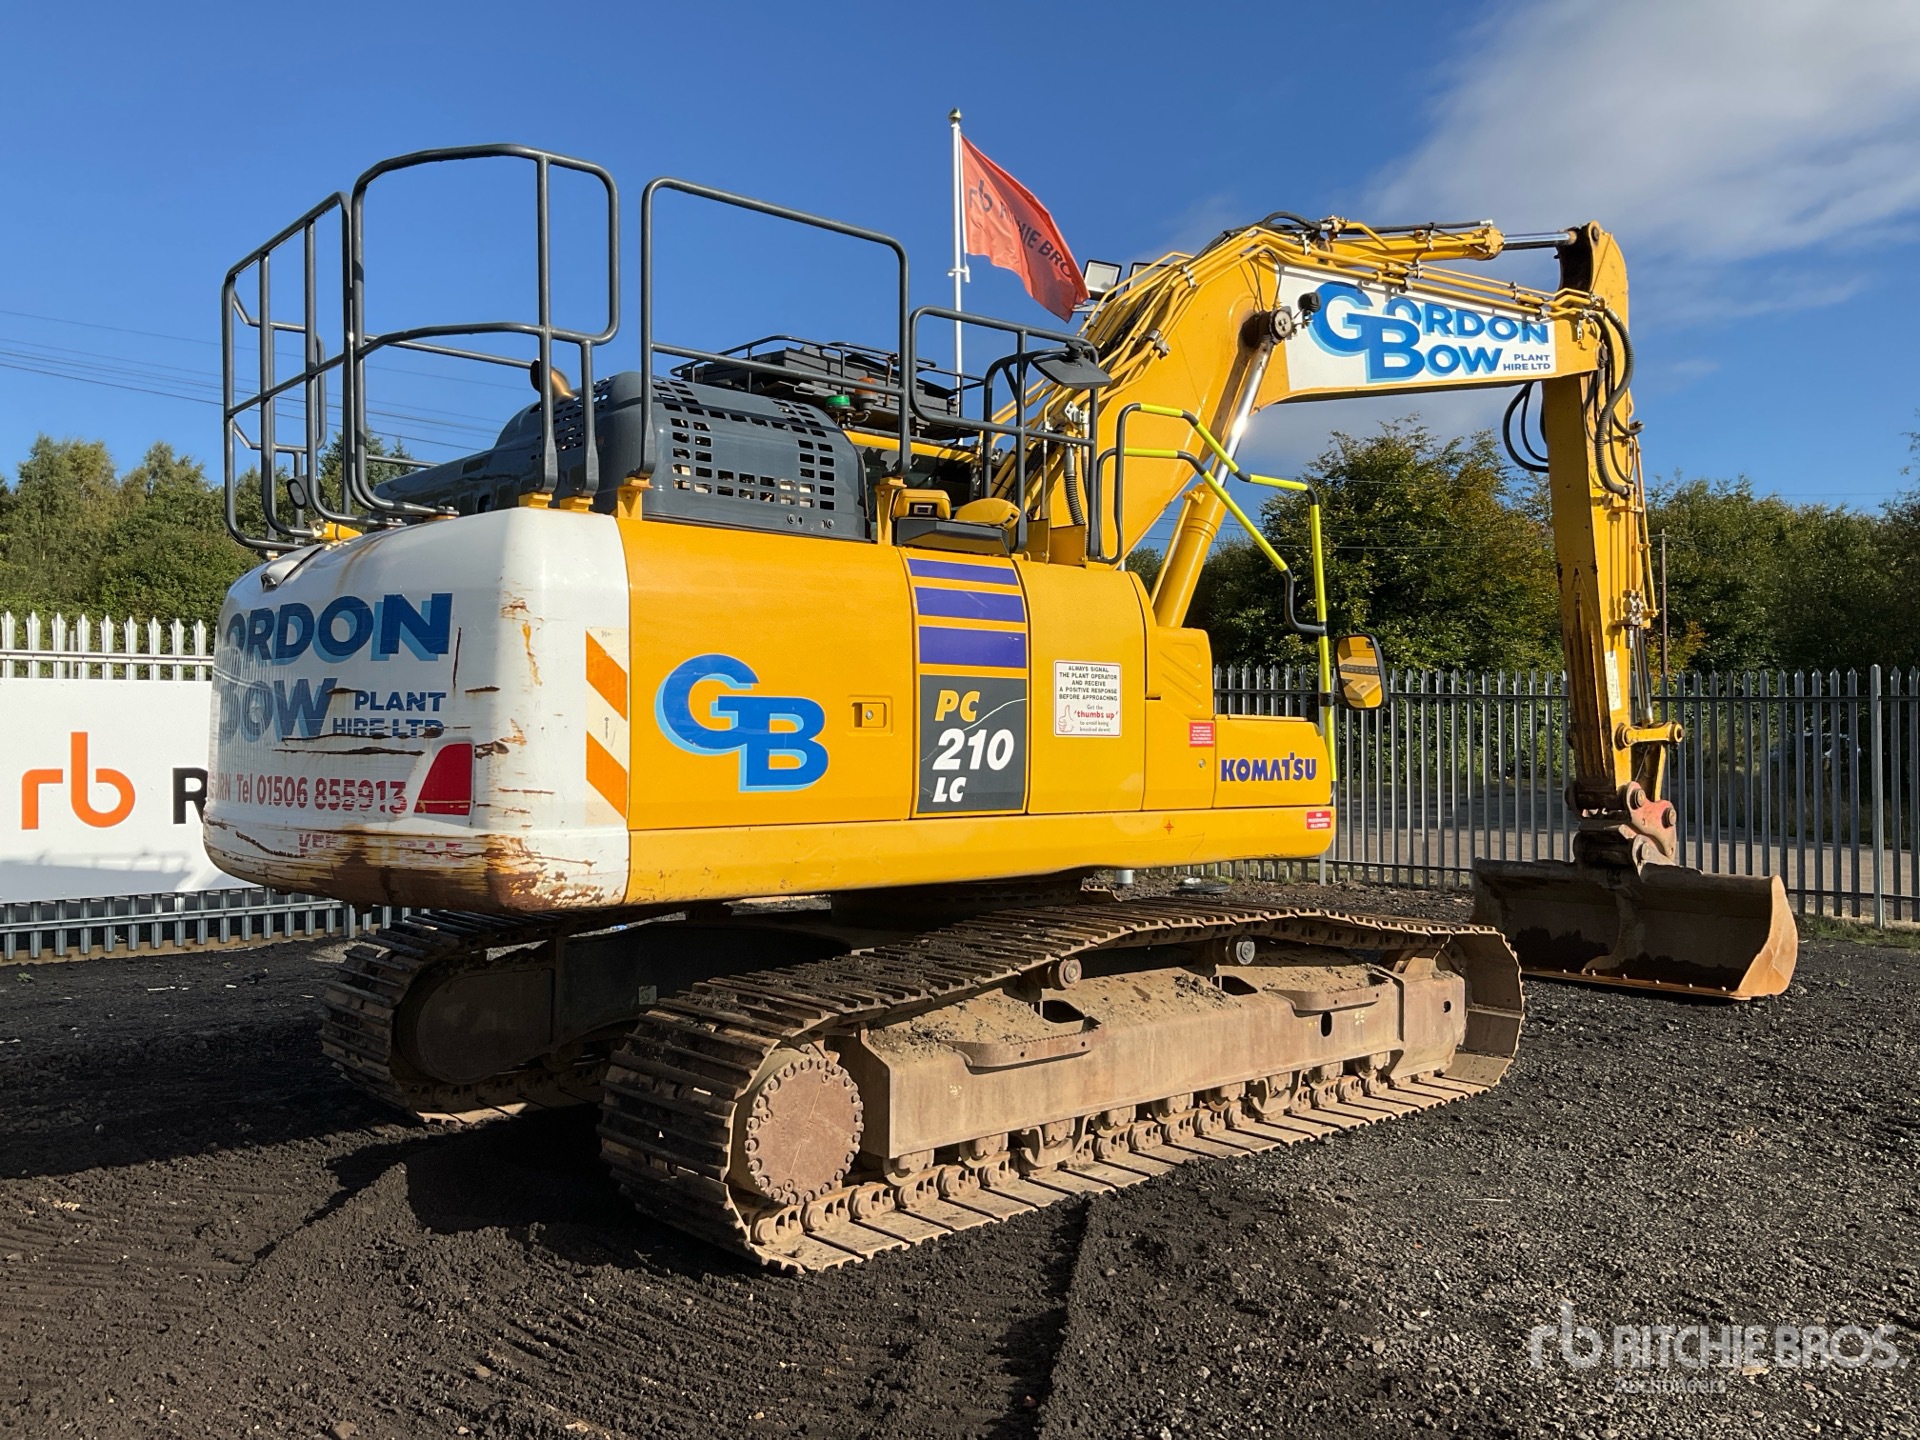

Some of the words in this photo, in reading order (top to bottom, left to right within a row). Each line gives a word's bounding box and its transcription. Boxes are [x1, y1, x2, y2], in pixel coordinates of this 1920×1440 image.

[1308, 281, 1550, 376] GORDON
[1343, 313, 1504, 382] BOW
[1503, 363, 1529, 371] HIRE
[1513, 353, 1551, 361] PLANT
[216, 593, 453, 667] ORDON
[354, 691, 447, 712] PLANT
[934, 689, 981, 723] PC
[332, 717, 386, 737] HIRE
[392, 719, 445, 739] LTD
[654, 653, 829, 793] GB
[932, 727, 1015, 771] 210
[1220, 752, 1317, 782] KOMATSU
[21, 731, 136, 830] rb
[236, 773, 253, 804] Tel
[257, 774, 309, 809] 01506
[314, 777, 408, 815] 855913
[932, 776, 967, 803] LC
